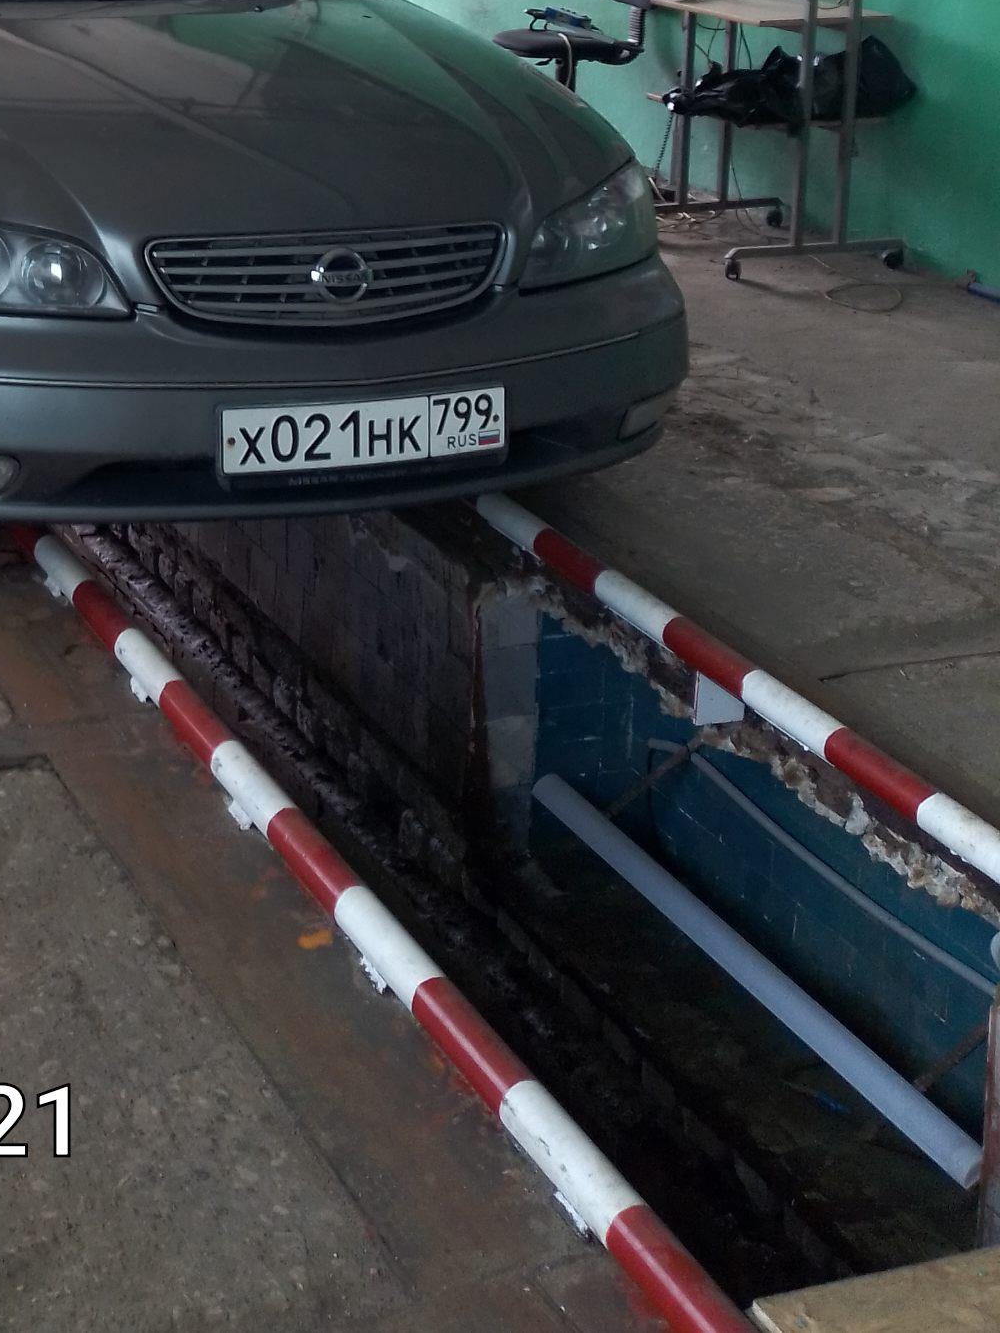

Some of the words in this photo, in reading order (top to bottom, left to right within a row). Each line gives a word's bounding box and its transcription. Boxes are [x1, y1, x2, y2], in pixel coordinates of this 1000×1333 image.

[239, 410, 423, 466] Х021НК
[432, 393, 494, 436] 799
[447, 432, 477, 450] RUS
